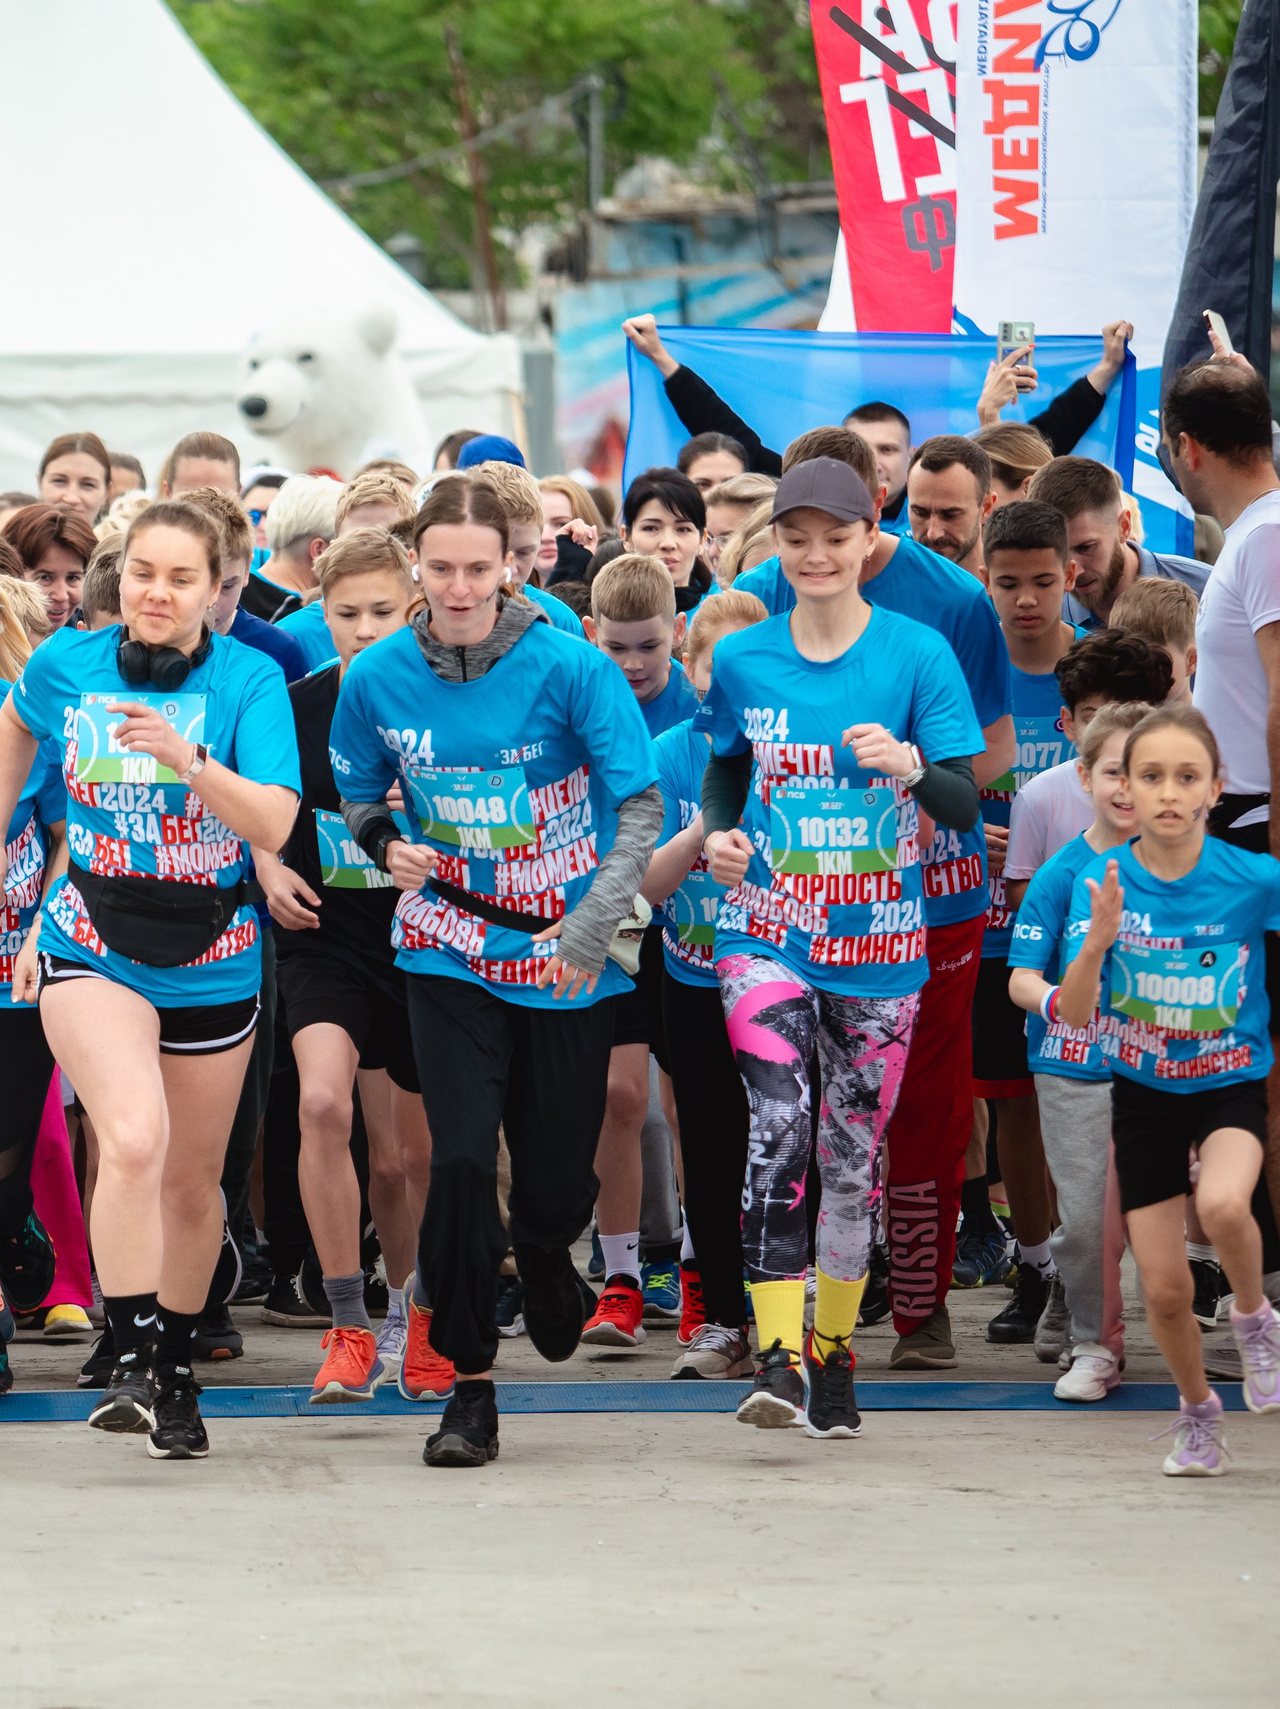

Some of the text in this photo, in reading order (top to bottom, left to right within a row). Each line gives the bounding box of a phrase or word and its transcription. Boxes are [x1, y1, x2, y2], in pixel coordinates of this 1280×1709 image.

[744, 707, 789, 742] 2024
[101, 783, 167, 813] 2024
[433, 795, 507, 825] 10048
[787, 791, 806, 799] ПСБ
[798, 817, 868, 847] 10132
[869, 896, 921, 934] 2024
[1135, 971, 1215, 1006] 10008
[888, 1180, 939, 1318] RUSSIA
